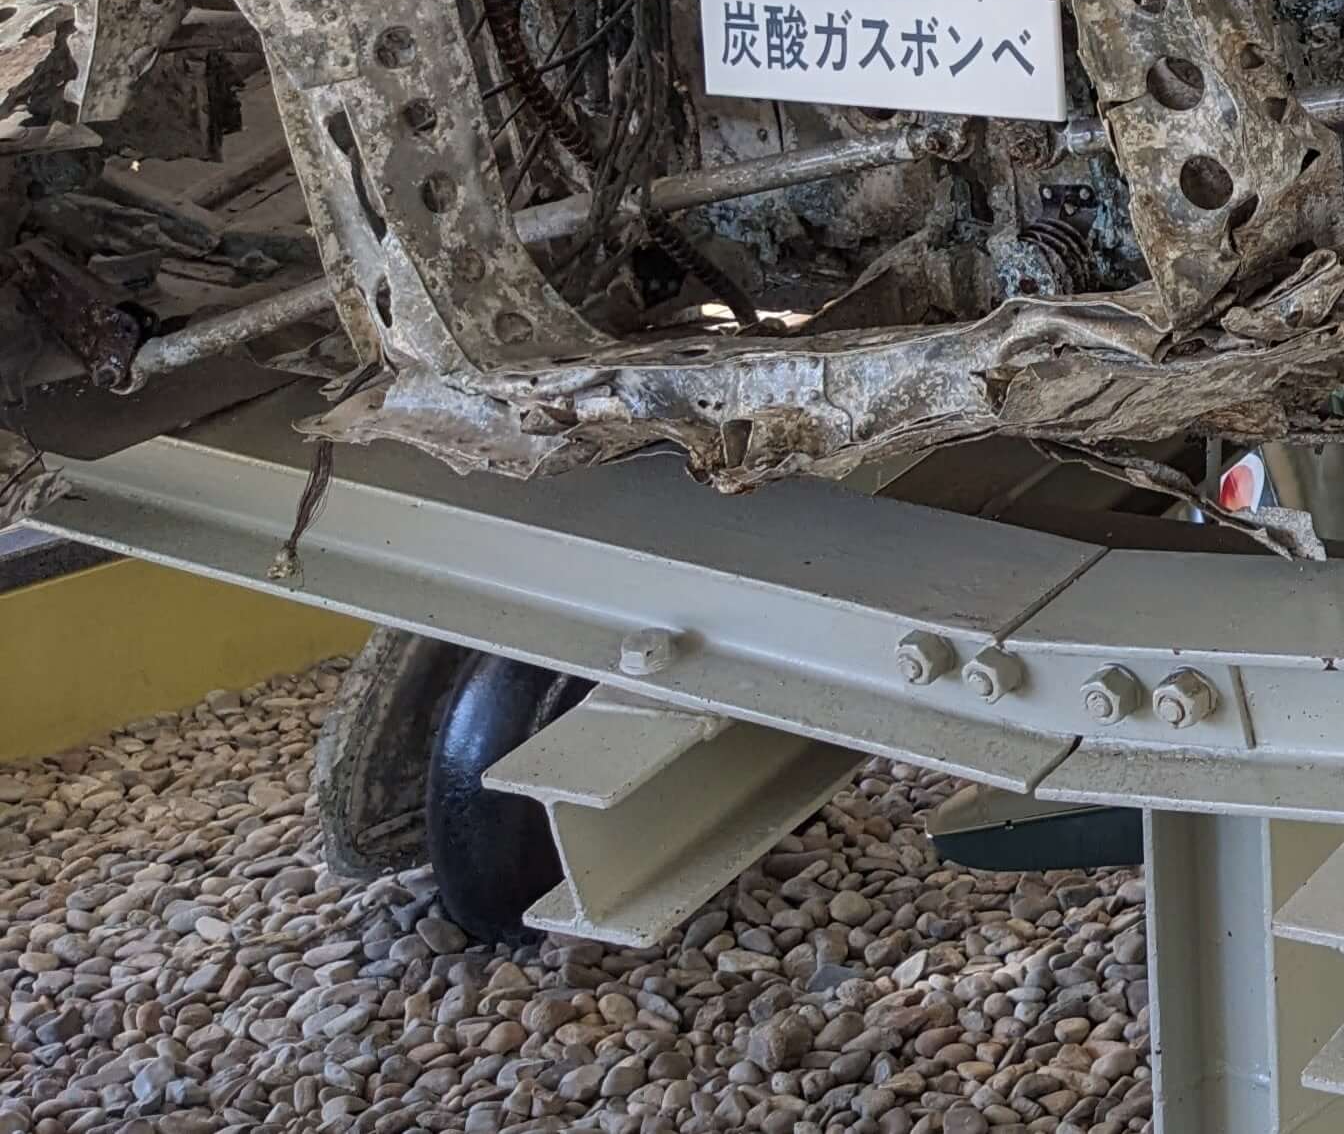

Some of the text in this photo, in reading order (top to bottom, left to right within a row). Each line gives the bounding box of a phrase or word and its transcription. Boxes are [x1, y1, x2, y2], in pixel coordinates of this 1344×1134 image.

[721, 0, 1036, 78] 炭酸ガスボンベ
